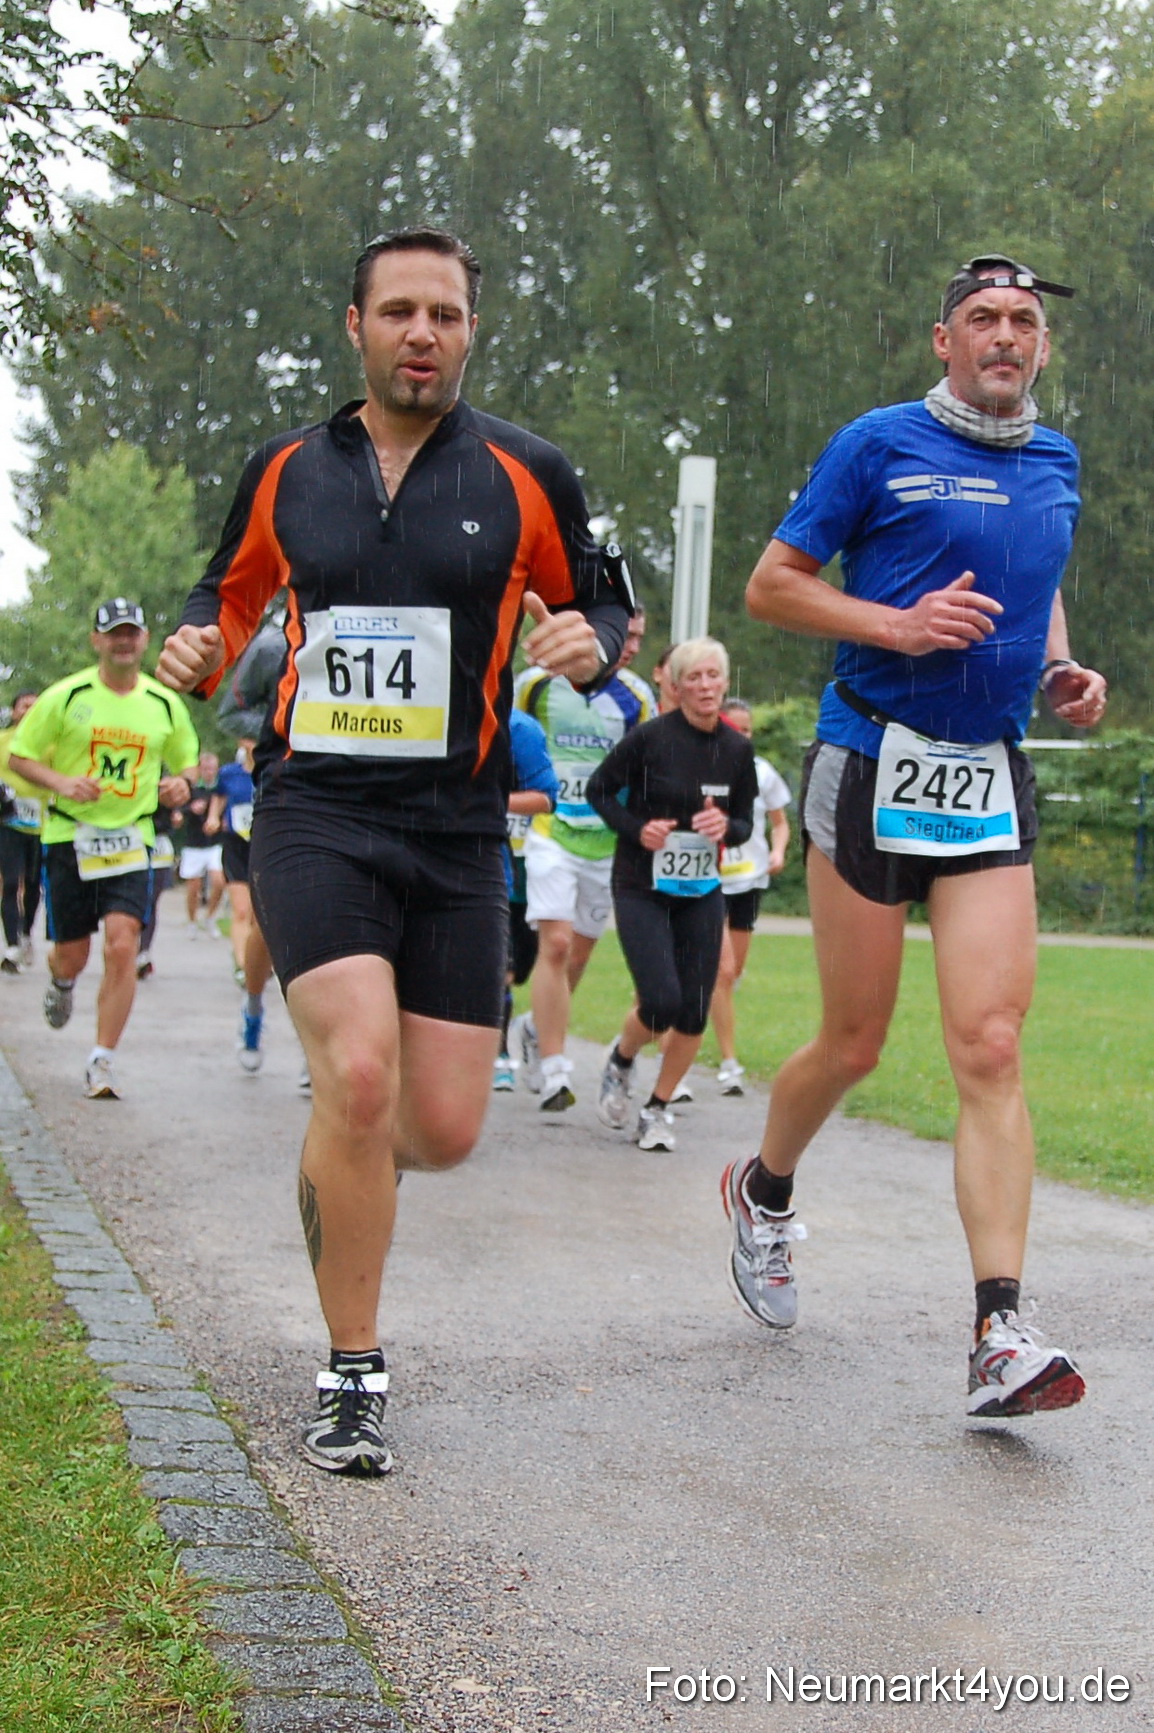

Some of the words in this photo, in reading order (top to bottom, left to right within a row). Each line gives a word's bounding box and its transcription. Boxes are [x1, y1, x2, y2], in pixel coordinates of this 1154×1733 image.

[325, 646, 416, 699] 614
[331, 711, 403, 734] Marcus
[101, 754, 127, 781] M
[892, 758, 995, 811] 2427
[904, 816, 985, 842] Siegfried
[661, 851, 713, 876] 3212
